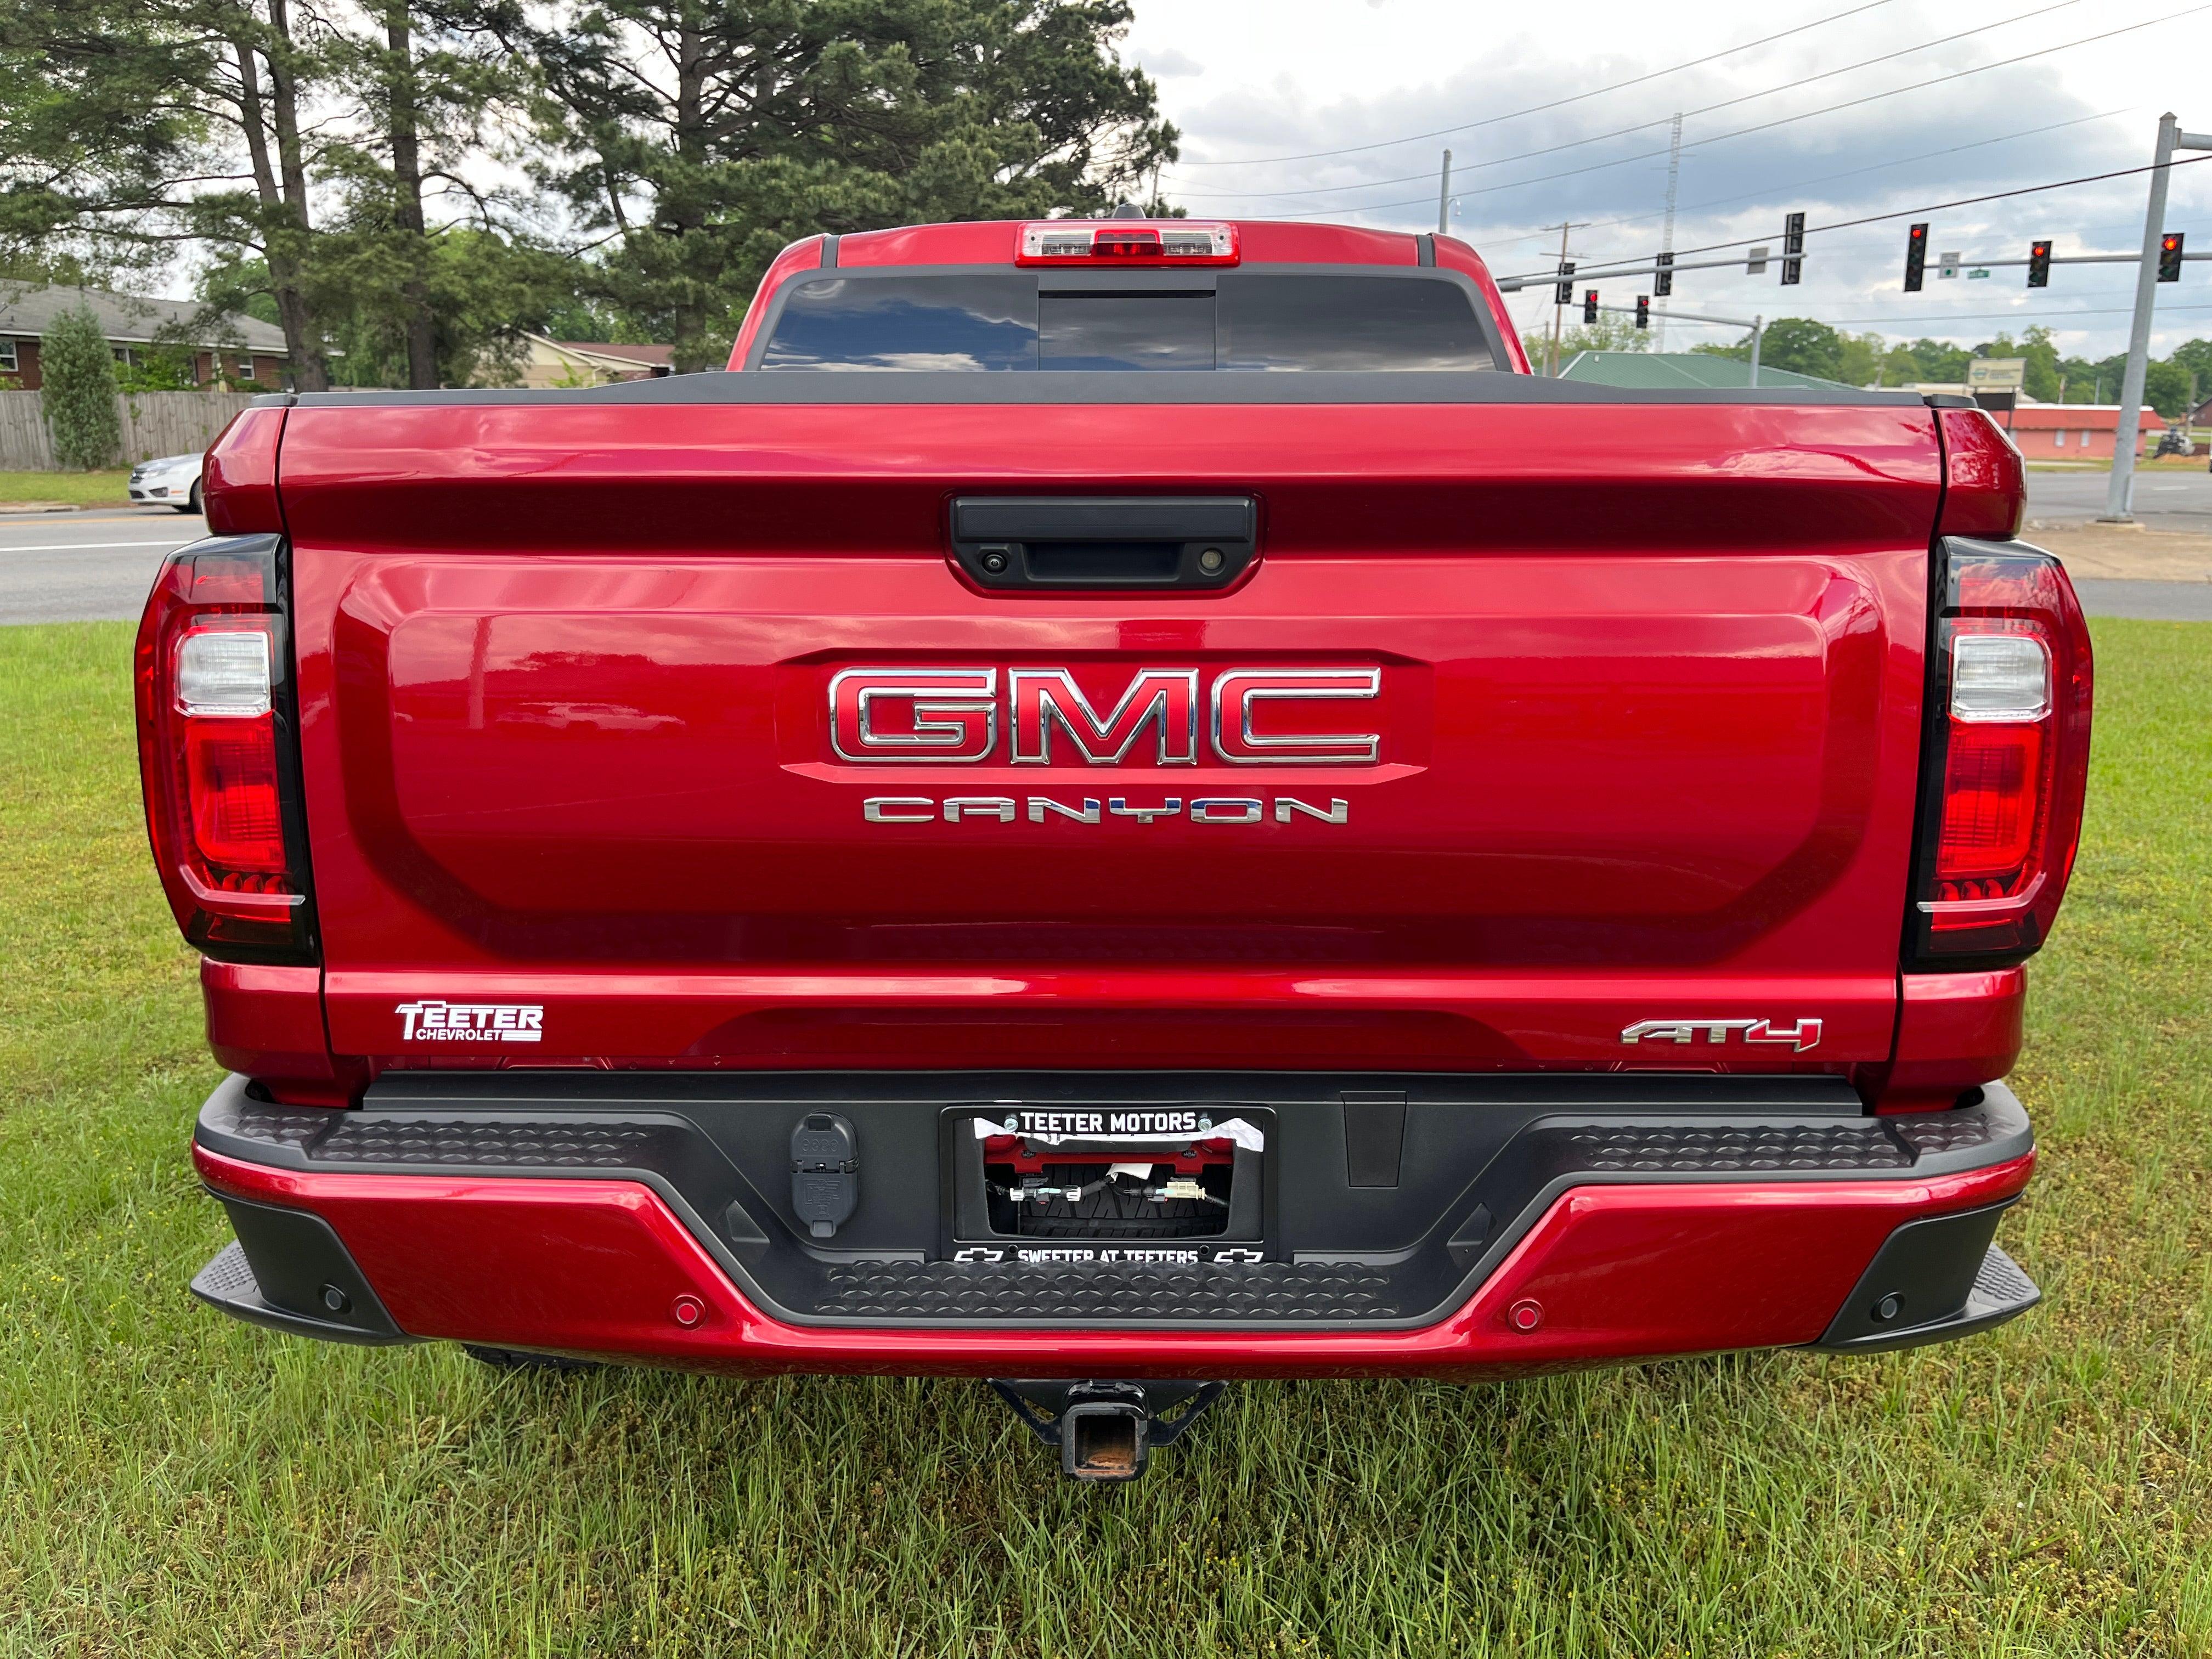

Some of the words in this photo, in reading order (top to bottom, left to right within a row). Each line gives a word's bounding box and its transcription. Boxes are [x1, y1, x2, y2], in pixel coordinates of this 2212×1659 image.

[828, 667, 1381, 765] GMC
[863, 797, 1348, 825] CANYON
[396, 1005, 544, 1040] TEETER
[416, 1028, 503, 1041] CHEVROLET
[1621, 1018, 1823, 1052] AT4
[1020, 1111, 1103, 1132] TEETER
[1110, 1111, 1196, 1132] MOTORS
[1018, 1249, 1094, 1263] SWEETER
[1099, 1249, 1120, 1263] AT
[1123, 1249, 1198, 1264] TEETERS
